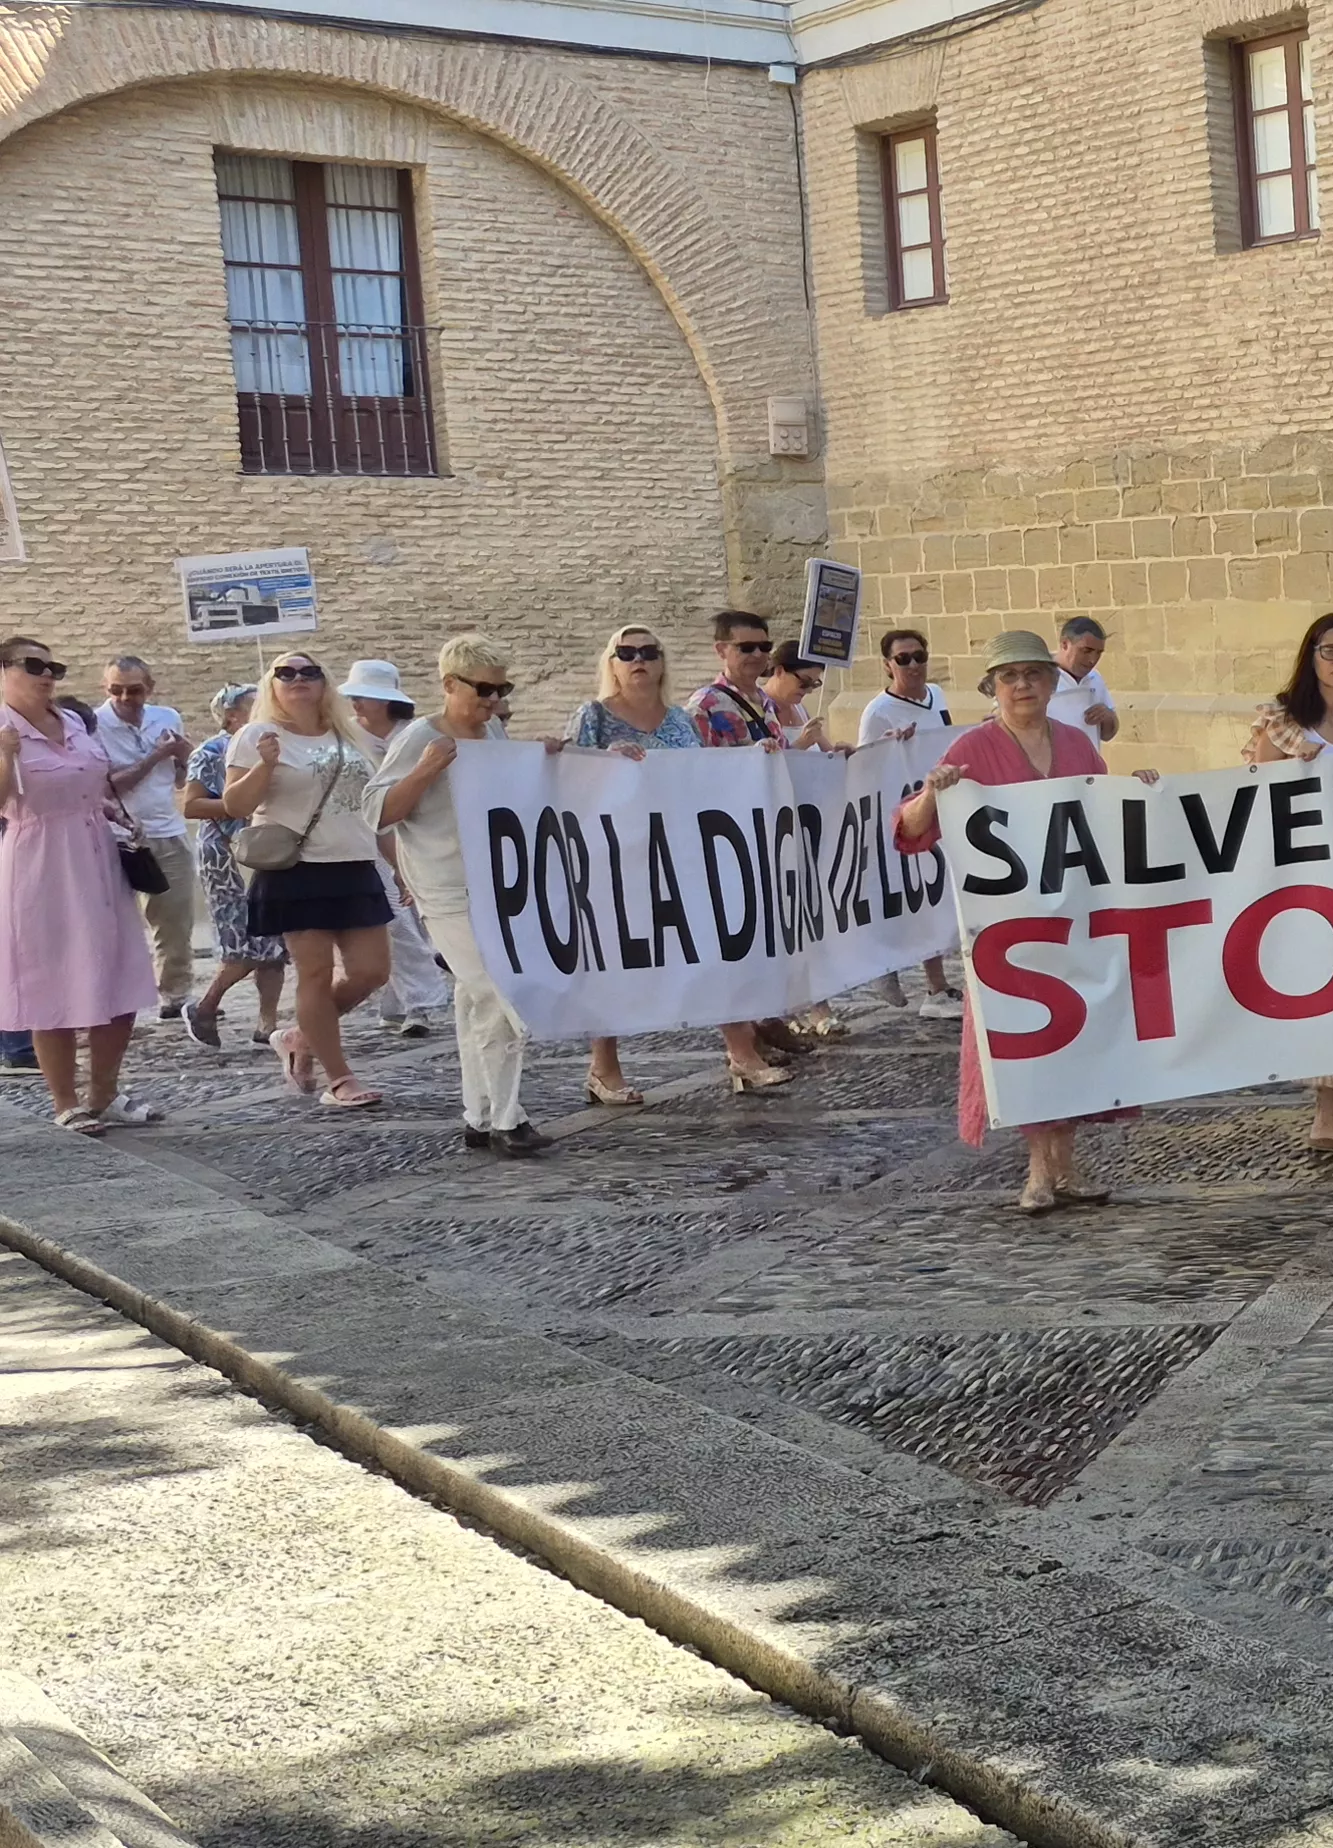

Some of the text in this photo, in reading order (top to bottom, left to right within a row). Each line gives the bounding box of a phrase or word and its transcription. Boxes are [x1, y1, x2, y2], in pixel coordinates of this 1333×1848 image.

[487, 806, 606, 975] POR
[600, 812, 701, 970] LA
[828, 794, 872, 934] DE
